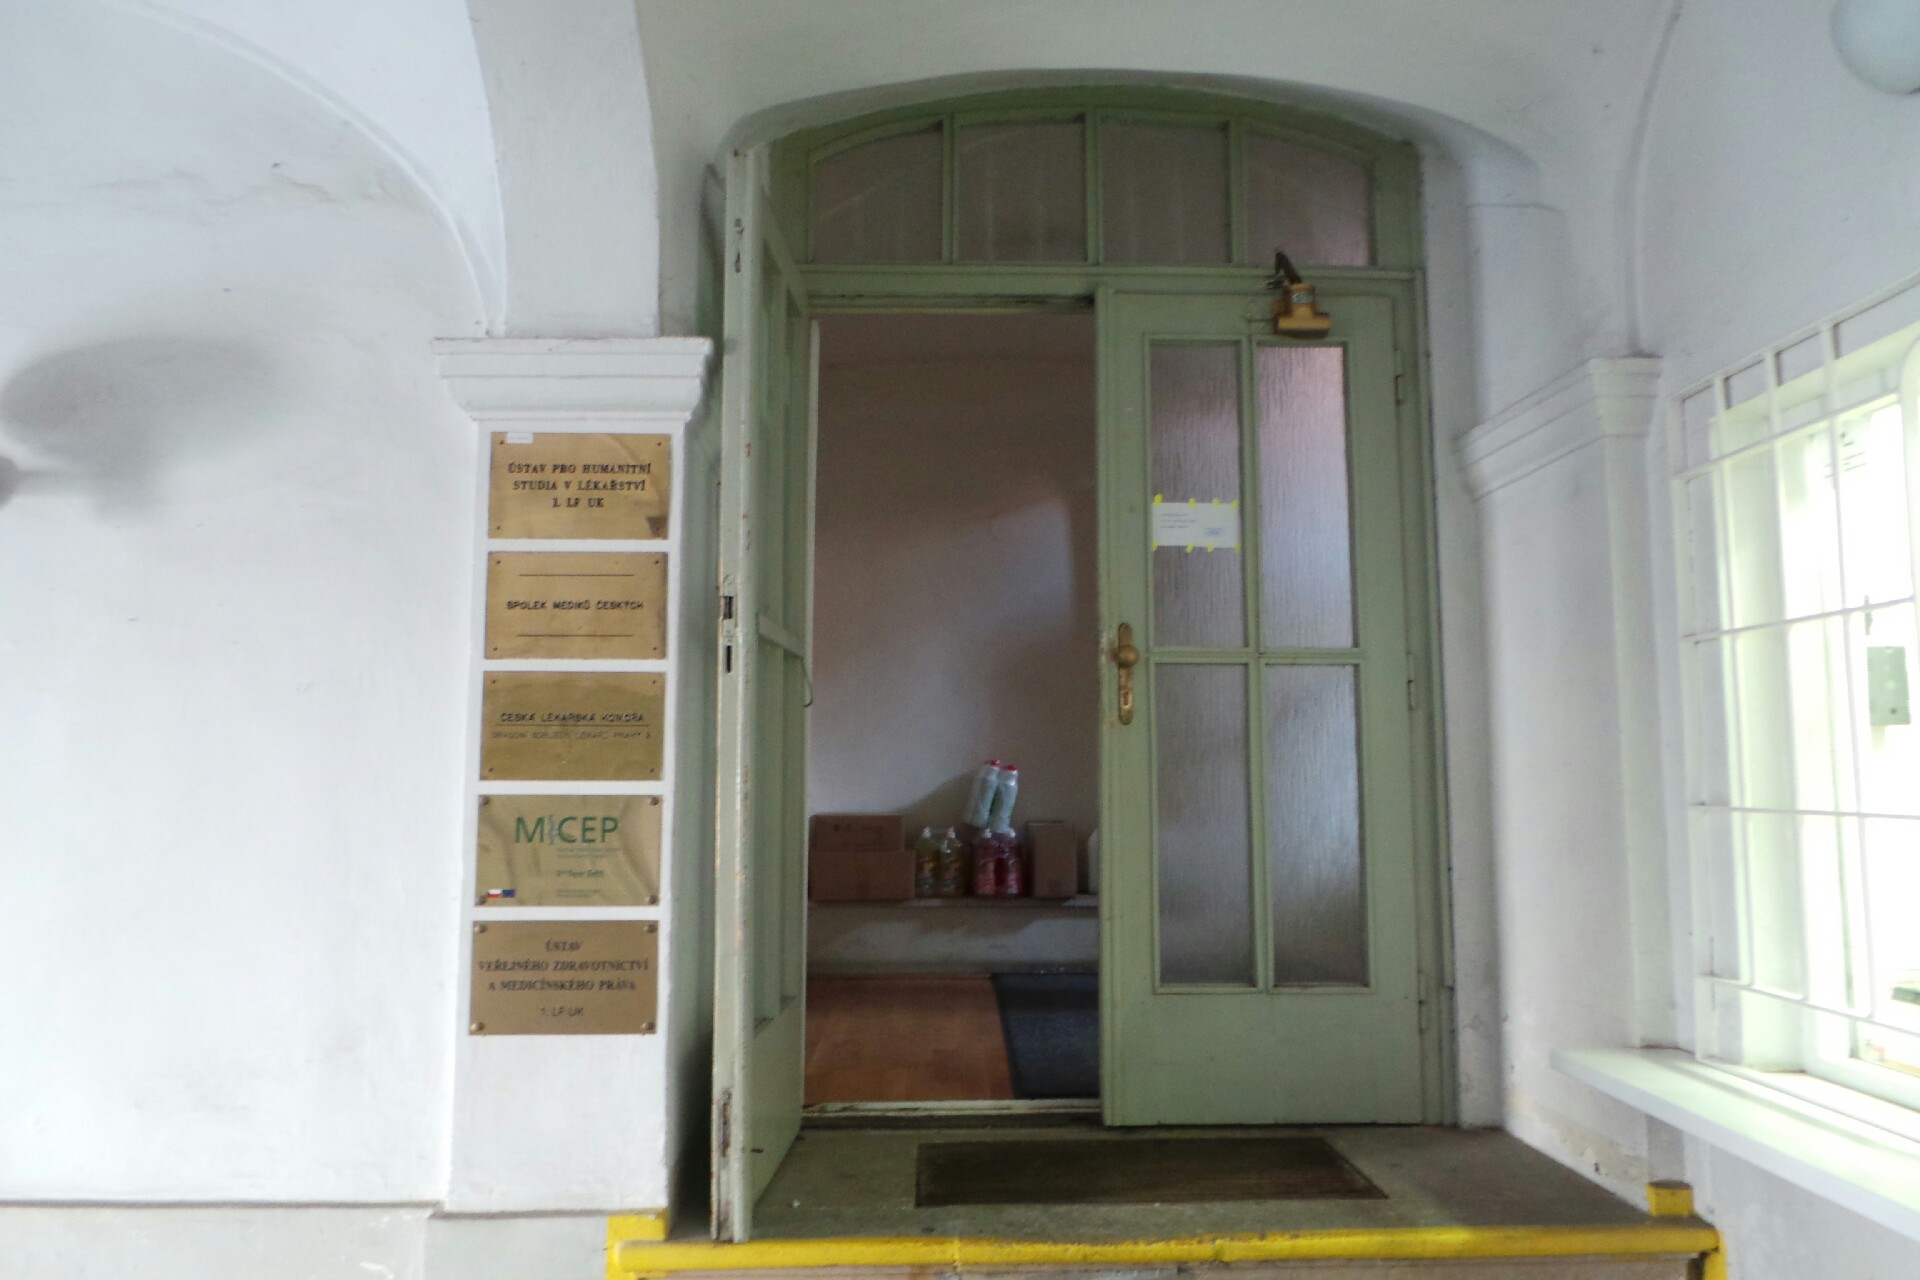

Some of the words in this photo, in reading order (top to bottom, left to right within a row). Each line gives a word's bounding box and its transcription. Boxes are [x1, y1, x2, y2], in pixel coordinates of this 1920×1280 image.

[508, 462, 547, 474] ÚSTAV
[552, 464, 577, 474] PRO
[582, 463, 651, 474] HUMANITNÍ
[512, 480, 557, 490] STUDIA
[564, 480, 572, 490] V
[578, 479, 646, 491] LÉKAŘSTVÍ
[567, 497, 580, 508] LF
[587, 497, 604, 508] UK
[506, 600, 547, 610] SPOLEK
[514, 815, 620, 845] MICEP
[488, 981, 496, 991] A
